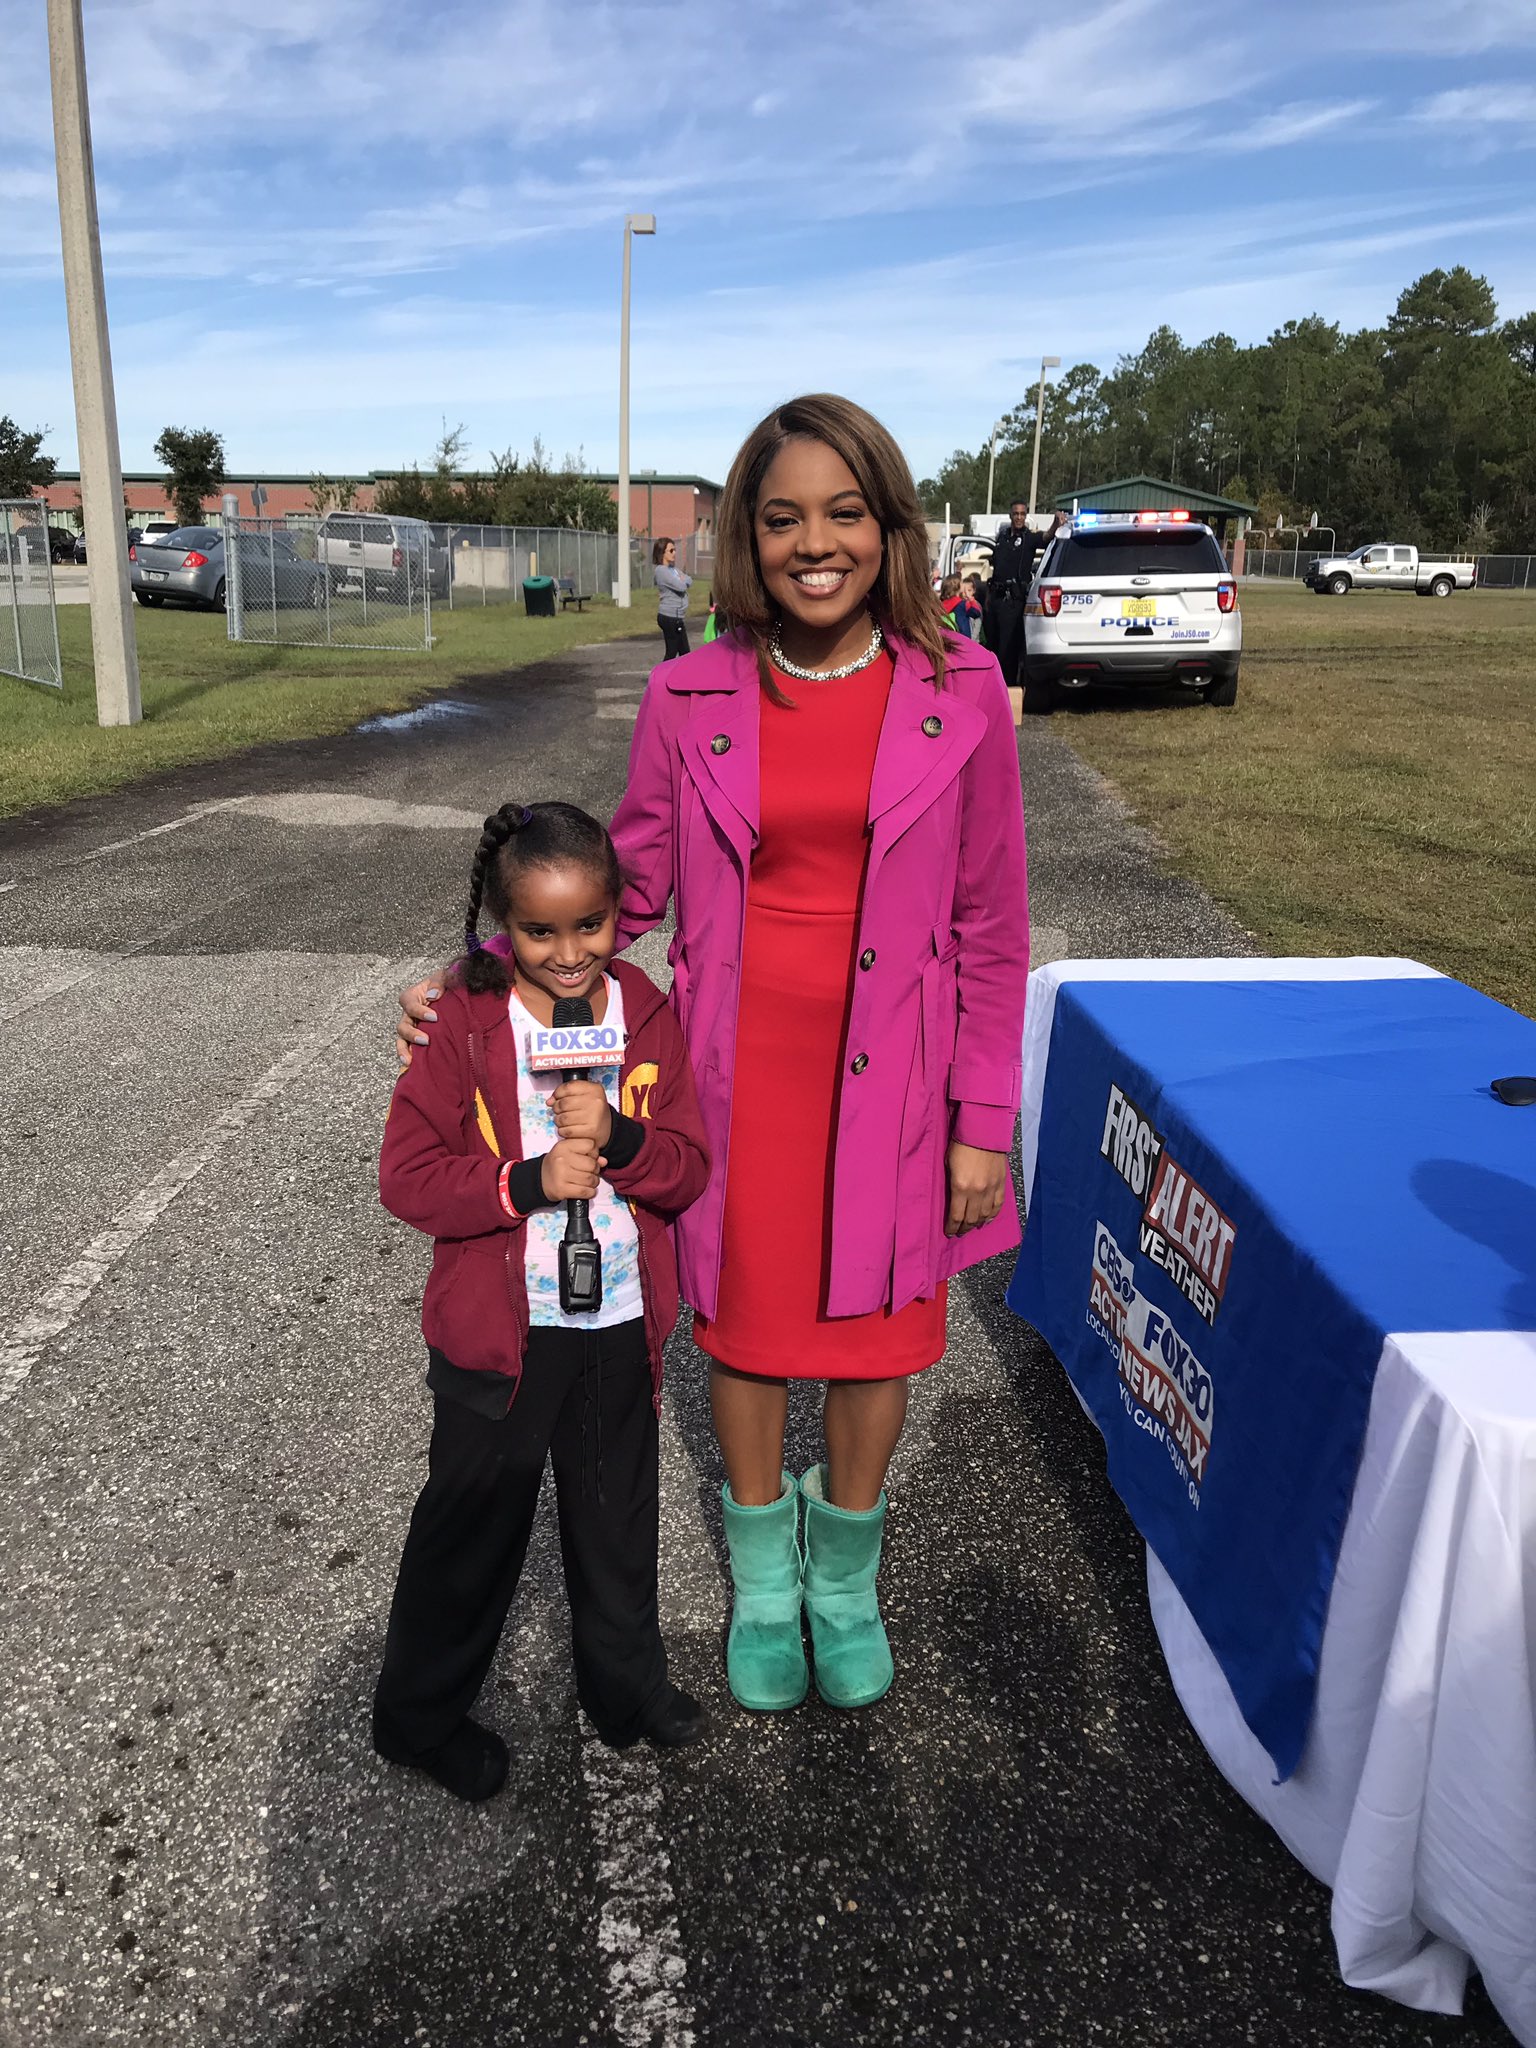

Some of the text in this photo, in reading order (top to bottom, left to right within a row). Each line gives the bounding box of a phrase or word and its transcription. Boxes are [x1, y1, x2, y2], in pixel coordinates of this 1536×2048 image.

[1063, 595, 1093, 605] 2756
[1101, 617, 1179, 628] POLICE
[1171, 630, 1211, 638] JoinJSO.com
[535, 1054, 622, 1067] ACTION NEWS JAX
[1100, 1083, 1161, 1203] FIRST
[1098, 1233, 1123, 1293] CBS
[1149, 1162, 1236, 1289] ALERT
[1138, 1223, 1216, 1327] WEATHER
[1085, 1309, 1111, 1345] LOCAL
[1134, 1409, 1166, 1442] CAN
[1188, 1481, 1200, 1511] ON
[1118, 1342, 1177, 1427] NEWS
[1175, 1412, 1208, 1481] JAX
